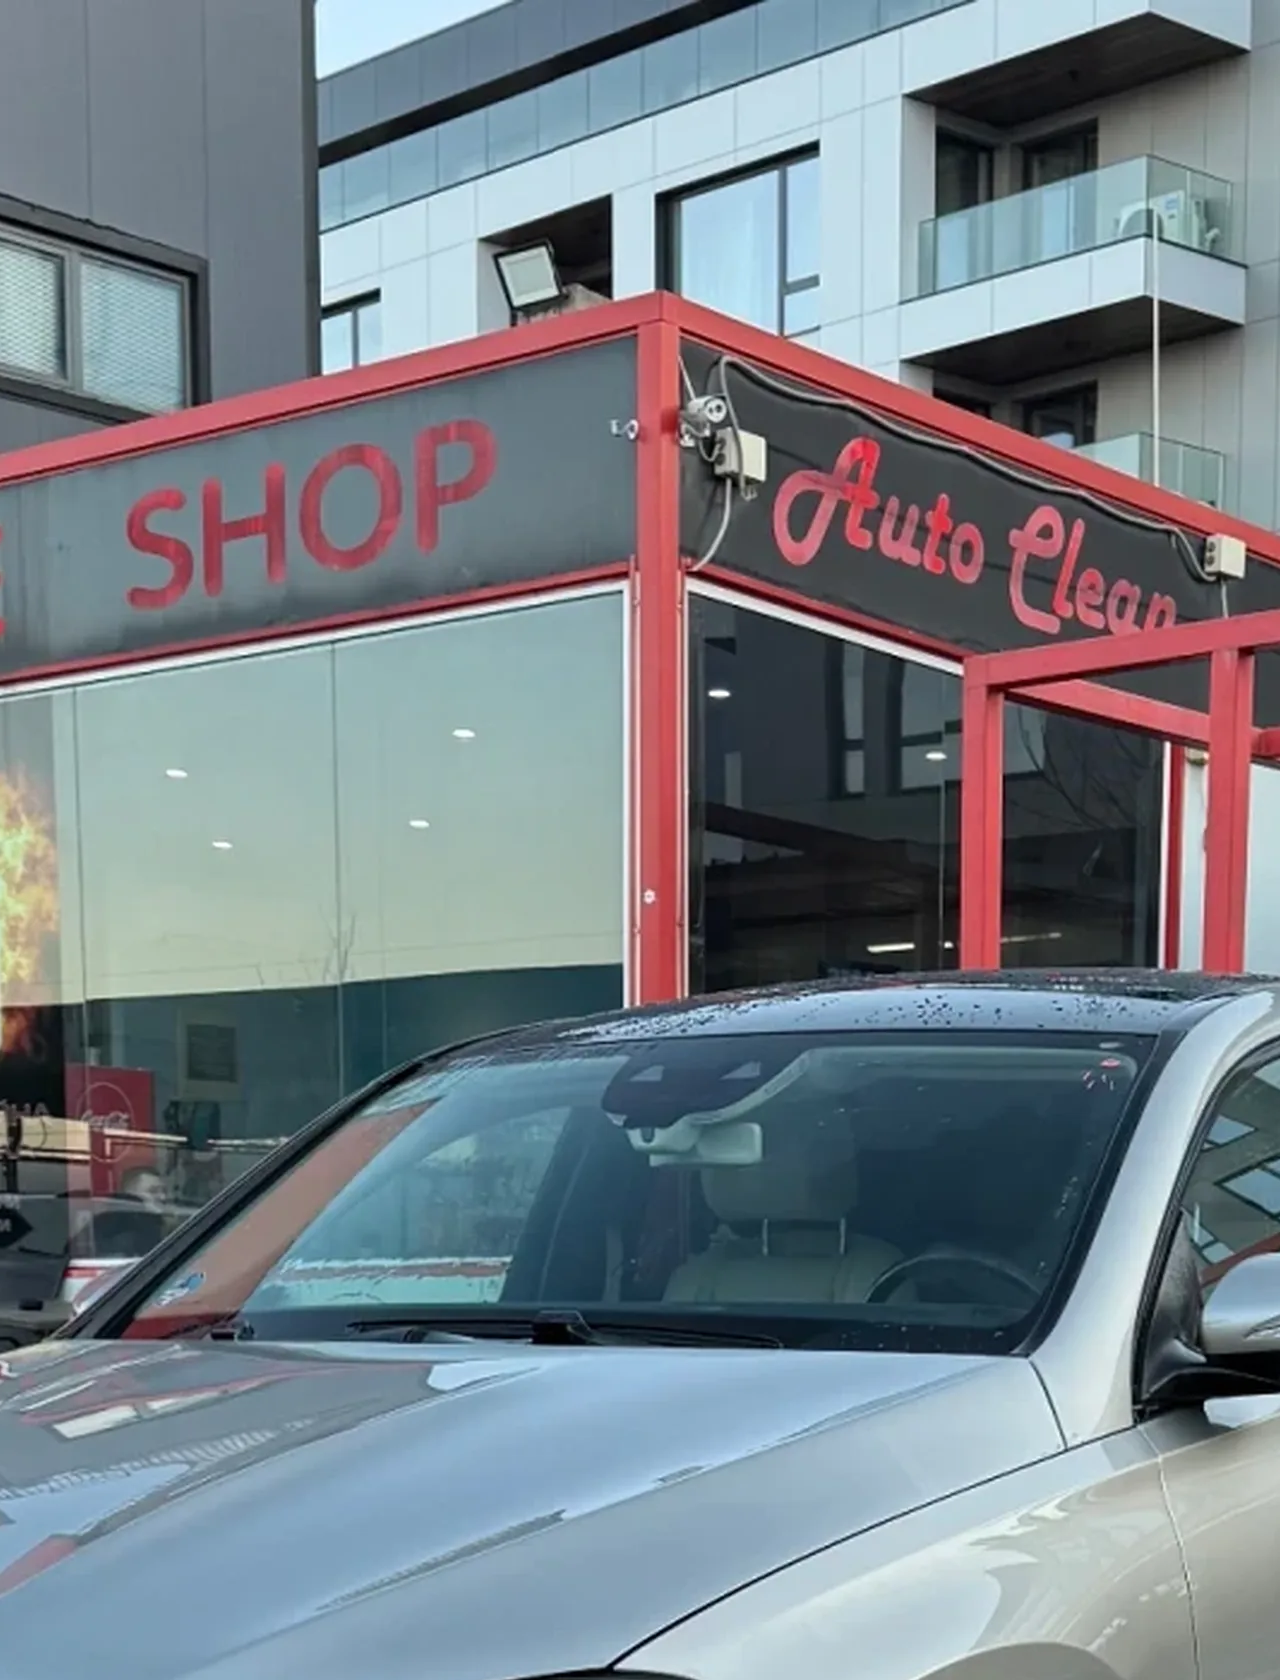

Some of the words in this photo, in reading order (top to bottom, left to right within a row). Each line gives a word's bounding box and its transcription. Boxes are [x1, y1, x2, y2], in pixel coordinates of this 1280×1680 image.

[126, 418, 500, 612] SHOP
[773, 436, 985, 585] Auto
[1008, 504, 1177, 636] Clean
